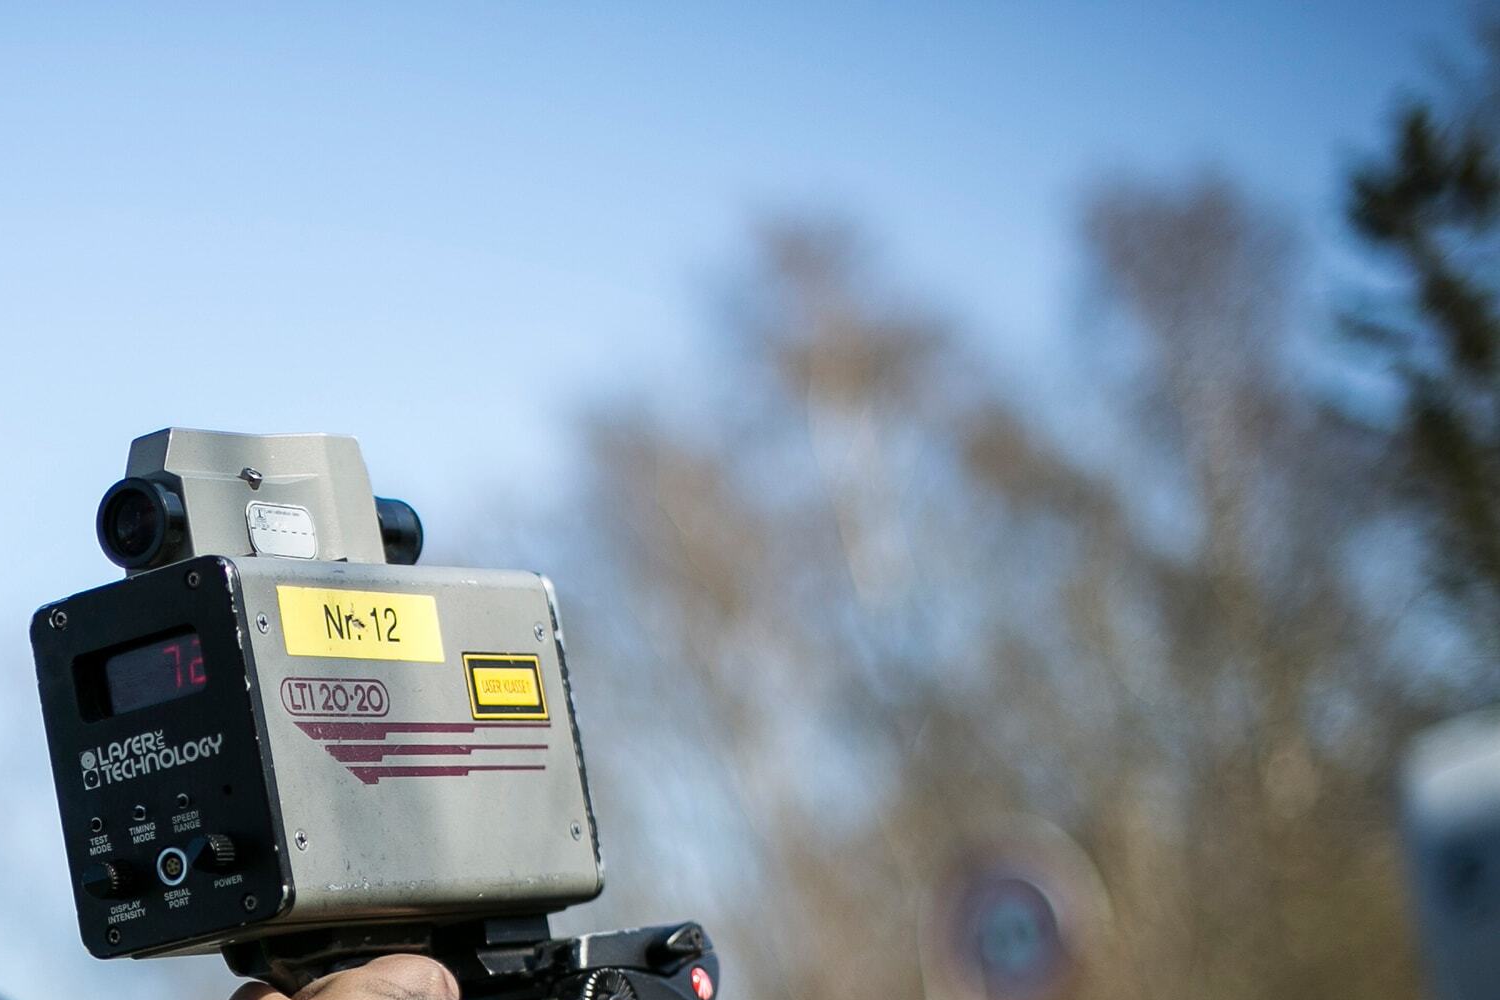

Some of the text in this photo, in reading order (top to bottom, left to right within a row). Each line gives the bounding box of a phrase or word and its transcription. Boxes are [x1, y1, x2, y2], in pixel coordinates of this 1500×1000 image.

[323, 604, 401, 642] Nr. 12
[288, 682, 315, 711] LTI
[97, 732, 156, 766] LASER
[100, 733, 223, 785] TECHNOLOGY
[128, 822, 156, 836] TIMING
[173, 818, 201, 833] RANGE
[89, 834, 108, 846] TEST
[132, 831, 156, 845] MODE
[89, 842, 113, 856] MODE
[213, 874, 243, 889] POWER
[163, 887, 191, 902] SERIAL
[110, 900, 141, 915] DISPLAY
[168, 897, 190, 909] PORT
[107, 908, 147, 924] INTENSITY
